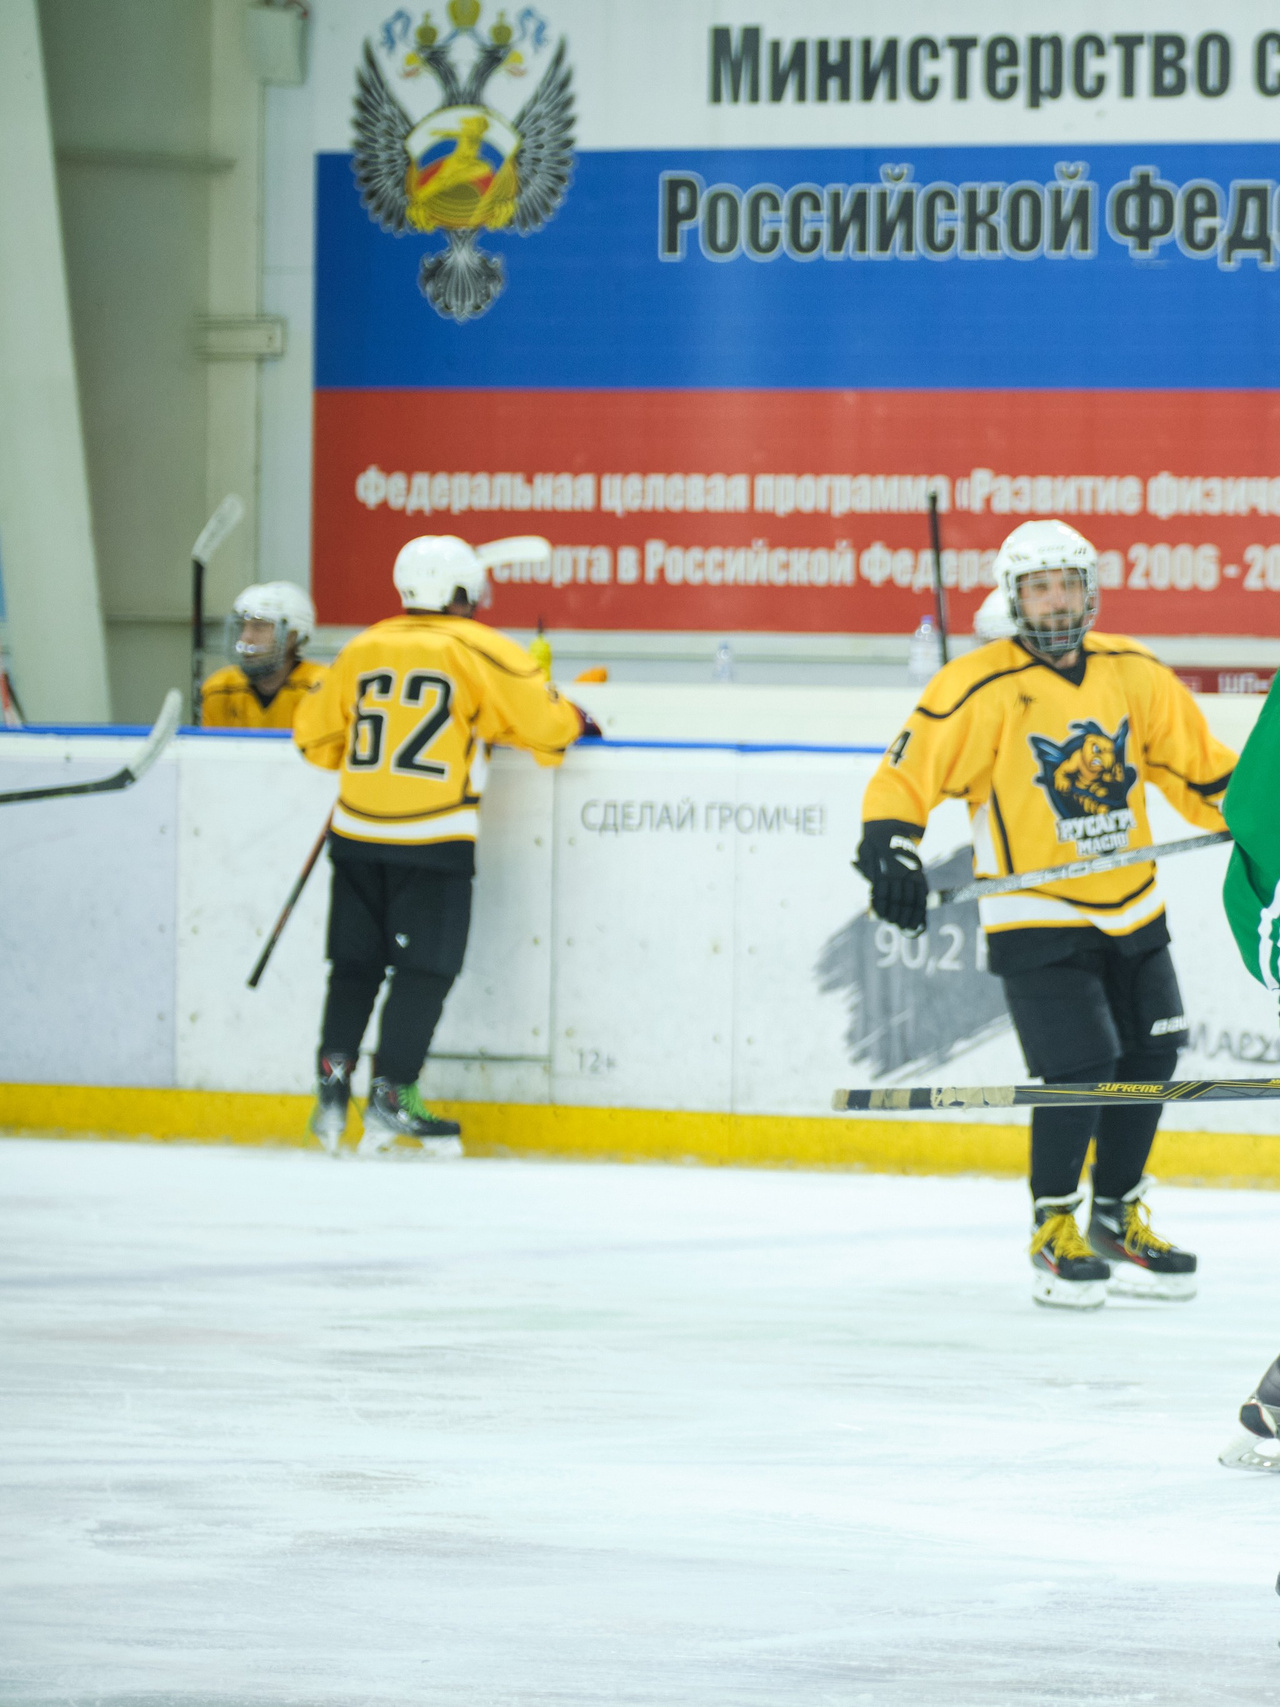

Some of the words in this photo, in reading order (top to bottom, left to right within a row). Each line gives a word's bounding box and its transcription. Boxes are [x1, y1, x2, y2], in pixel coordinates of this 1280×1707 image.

[709, 25, 1231, 109] Министерство
[659, 162, 1097, 261] Российской
[355, 464, 597, 517] Федеральная
[600, 472, 748, 518] целевая
[954, 467, 1143, 515] «Развитие
[616, 545, 640, 585] в
[643, 537, 856, 588] Российской
[858, 541, 1000, 594] Федера
[1127, 542, 1220, 592] 2006
[348, 669, 454, 781] 62
[580, 797, 697, 838] СДЕЛАЙ
[704, 800, 828, 837] ГРОМЧЕ!
[874, 920, 965, 978] 90,2
